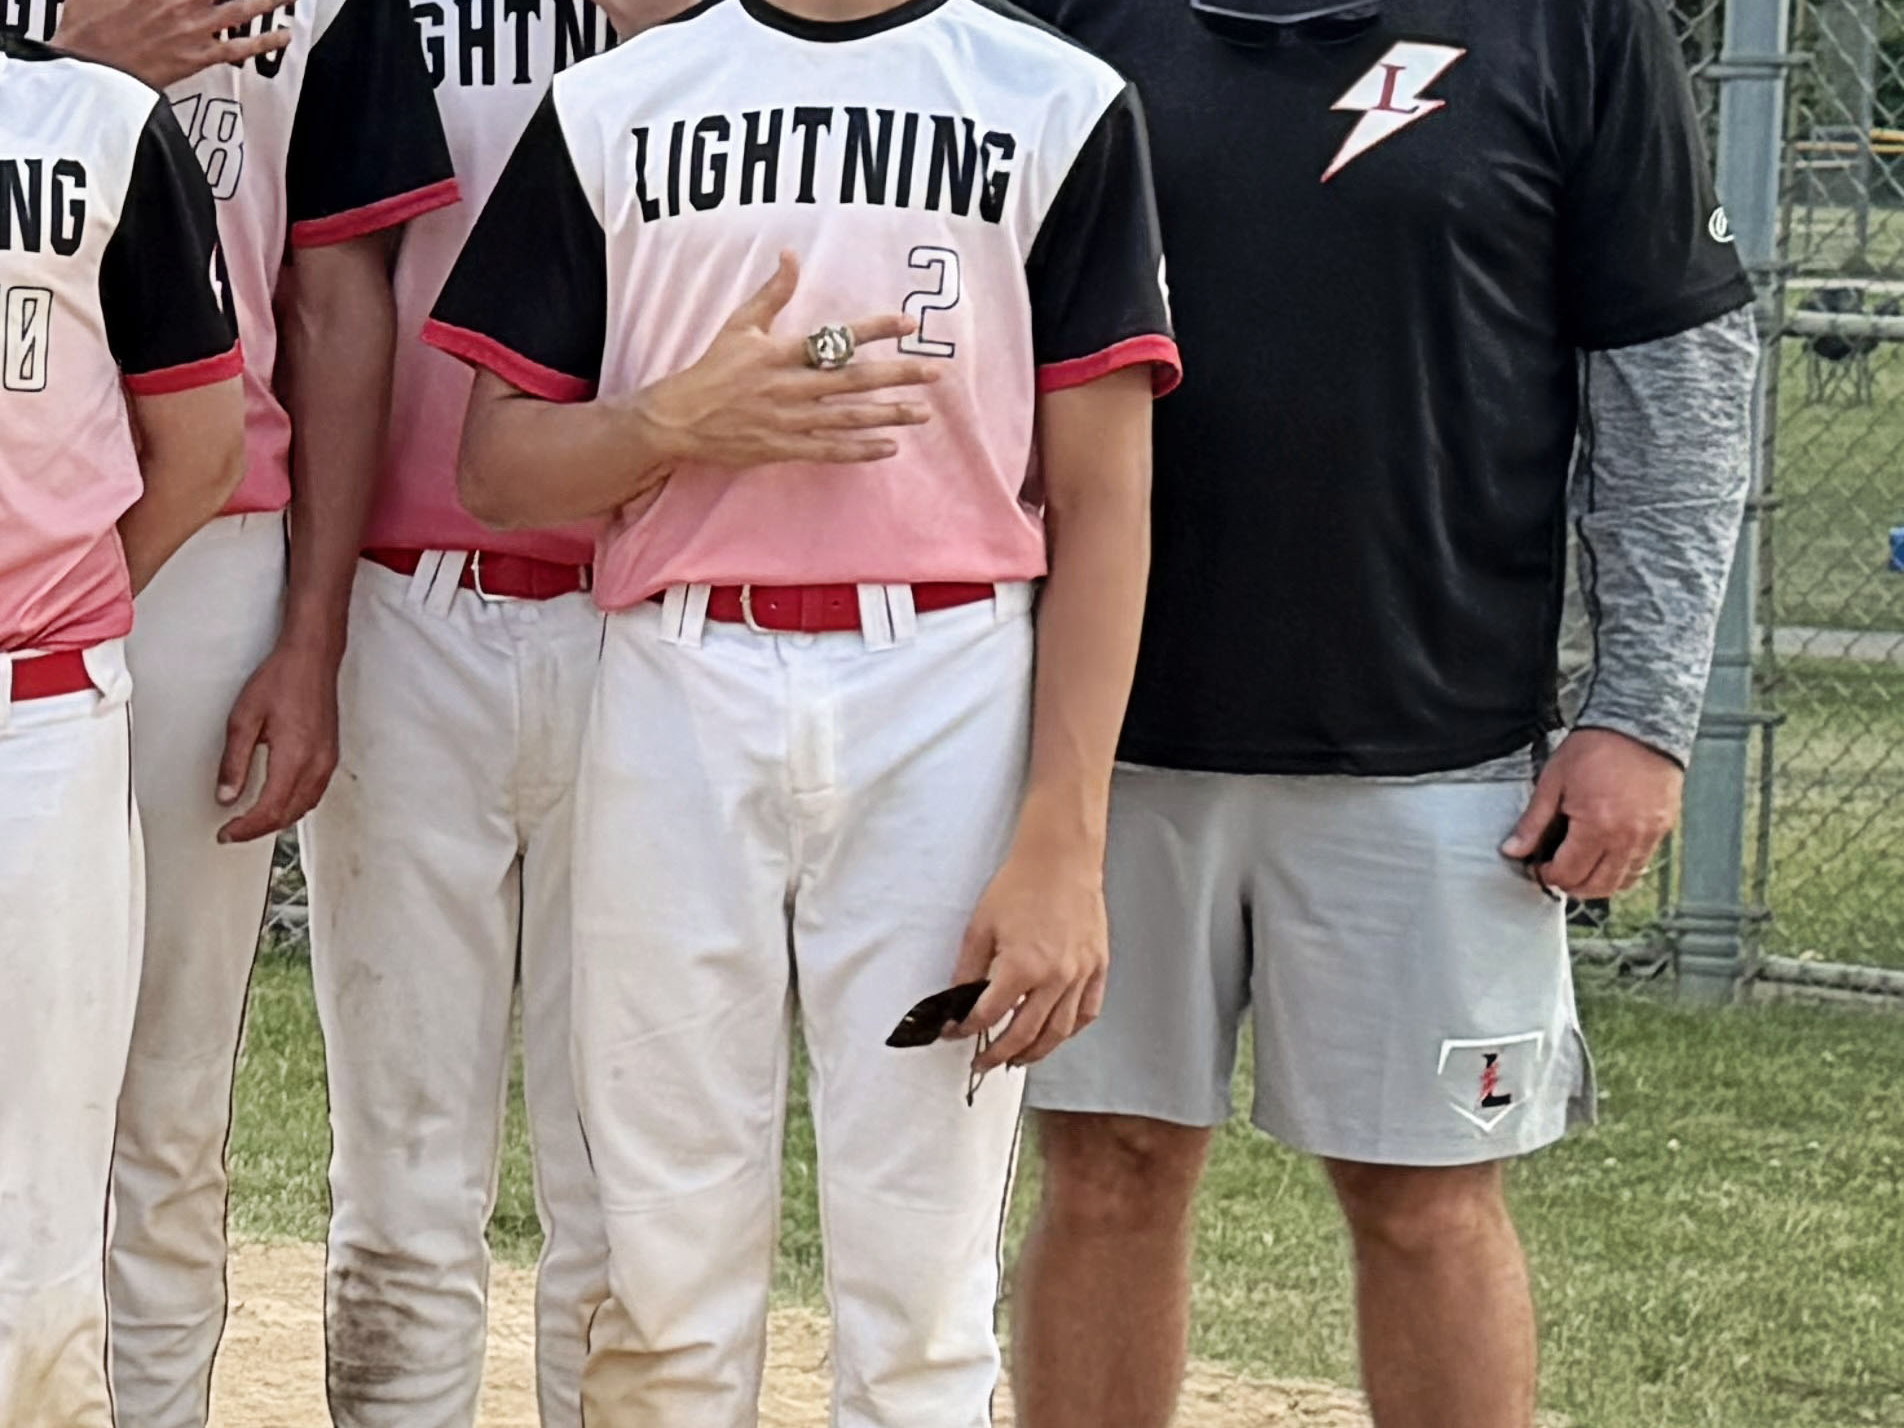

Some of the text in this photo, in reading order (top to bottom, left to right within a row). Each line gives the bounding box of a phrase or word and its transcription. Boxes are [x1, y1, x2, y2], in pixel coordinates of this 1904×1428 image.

[1372, 63, 1420, 114] L
[631, 107, 1015, 224] LIGHTNING
[898, 245, 960, 357] 2
